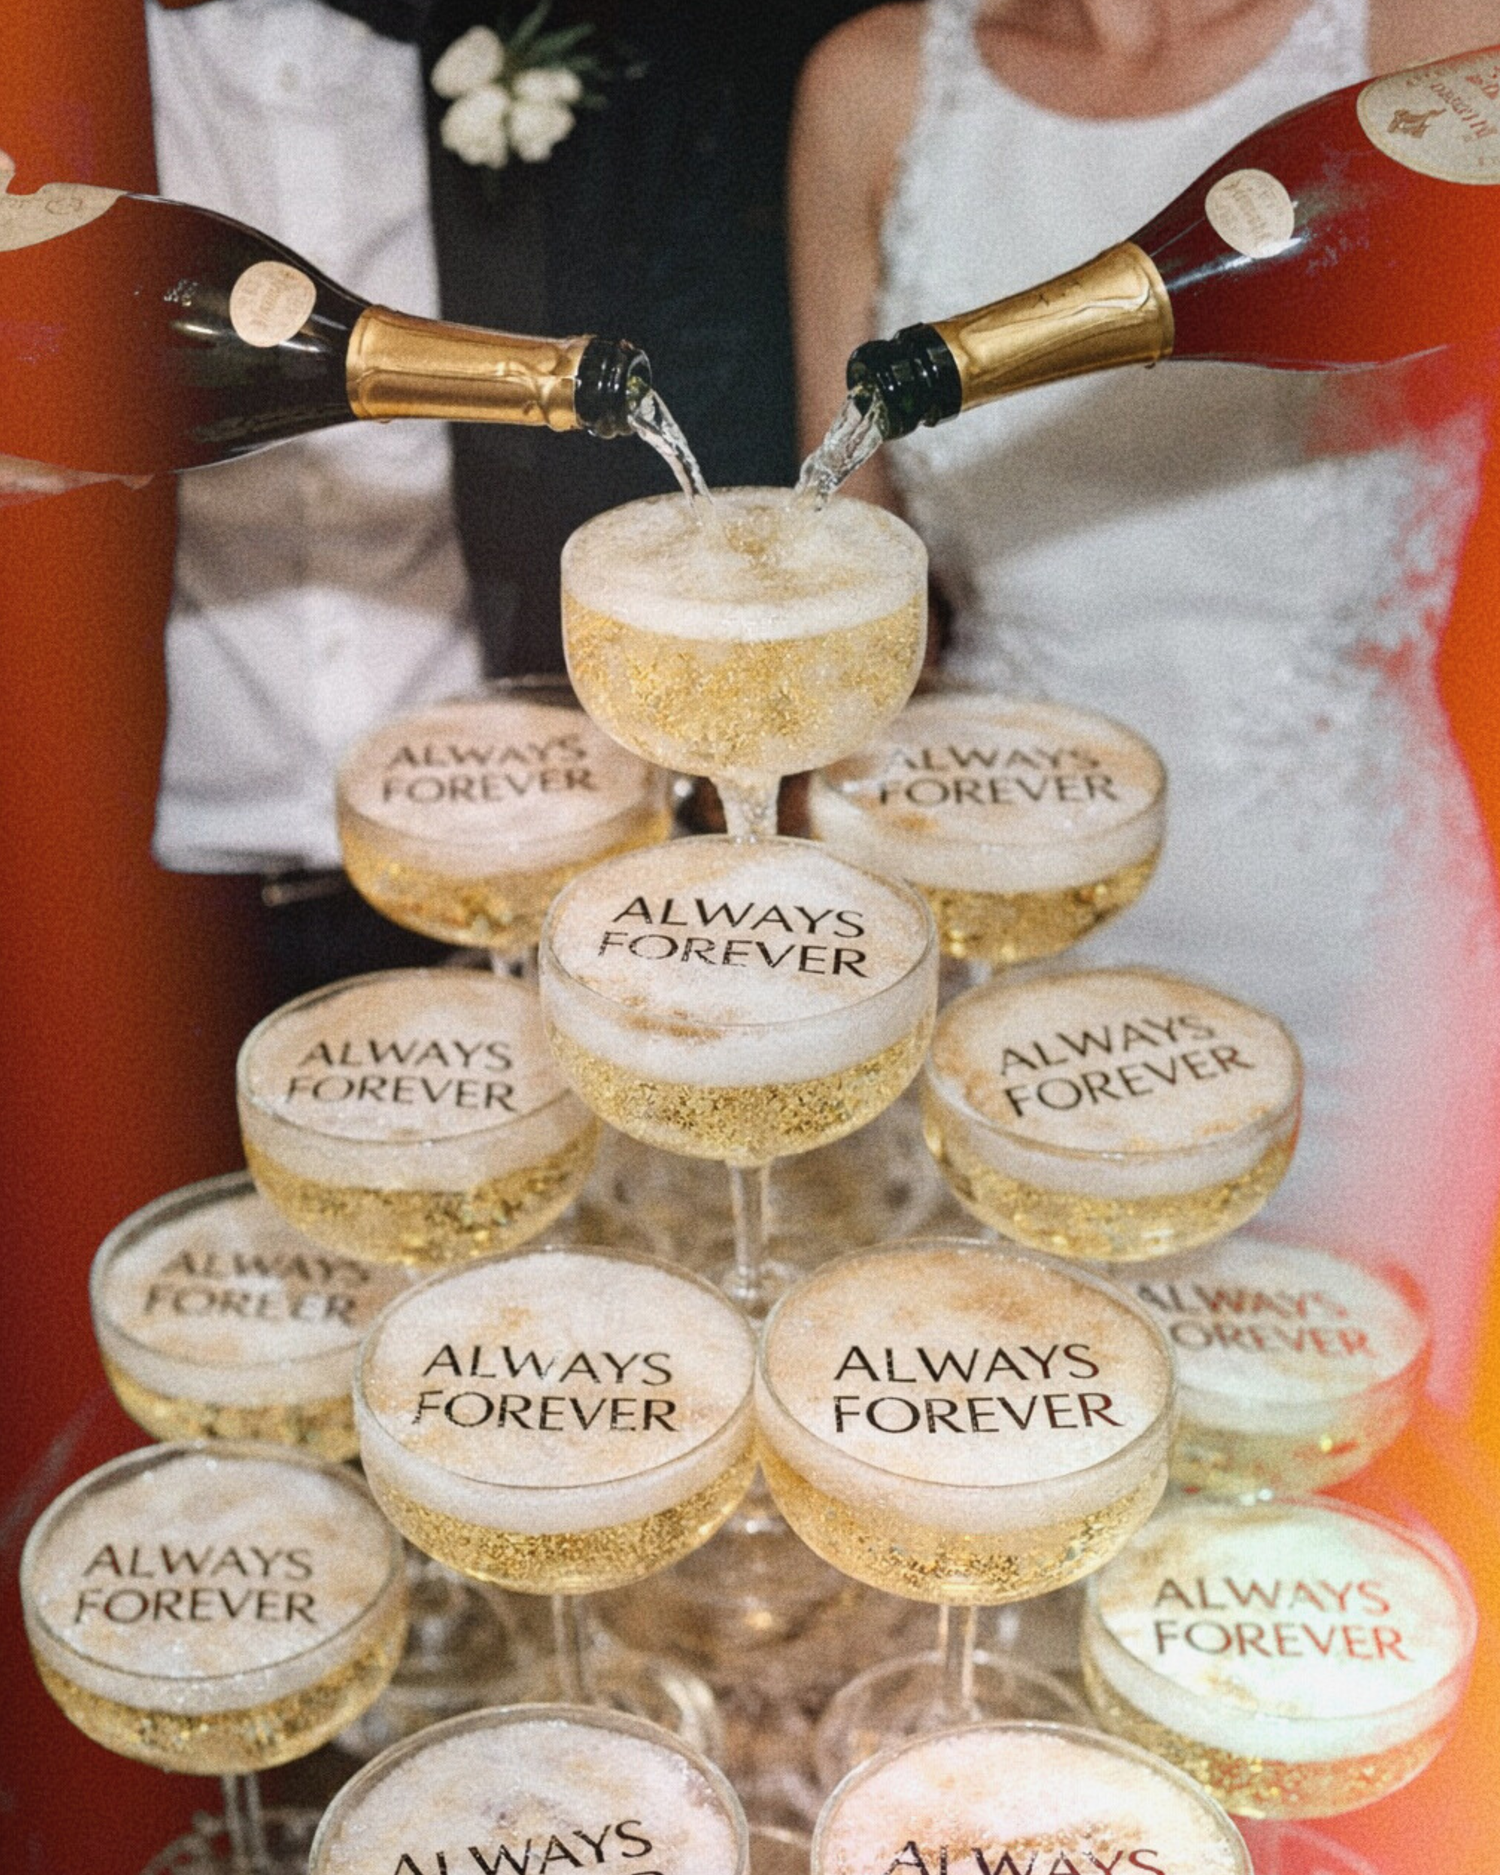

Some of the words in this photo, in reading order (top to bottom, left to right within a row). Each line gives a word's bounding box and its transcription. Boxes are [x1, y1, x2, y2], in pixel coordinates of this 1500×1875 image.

[384, 733, 588, 769] ALWAYS
[884, 745, 1101, 773] ALWAYS
[382, 767, 600, 803] FOREVER
[879, 775, 1119, 806] FOREVER
[612, 896, 866, 938] ALWAYS
[598, 931, 870, 978] FOREVER
[298, 1039, 514, 1072] ALWAYS
[1000, 1013, 1216, 1076] ALWAYS
[284, 1076, 517, 1111] FOREVER
[1003, 1045, 1255, 1117] FOREVER
[1169, 1319, 1377, 1359] OREVER
[421, 1344, 673, 1386] ALWAYS
[834, 1344, 1101, 1383] ALWAYS
[412, 1390, 680, 1432] FOREVER
[833, 1393, 1125, 1434] FOREVER
[83, 1544, 314, 1582] ALWAYS
[74, 1588, 318, 1625] FOREVER
[1154, 1576, 1392, 1617] ALWAYS
[1154, 1619, 1414, 1662] FOREVER
